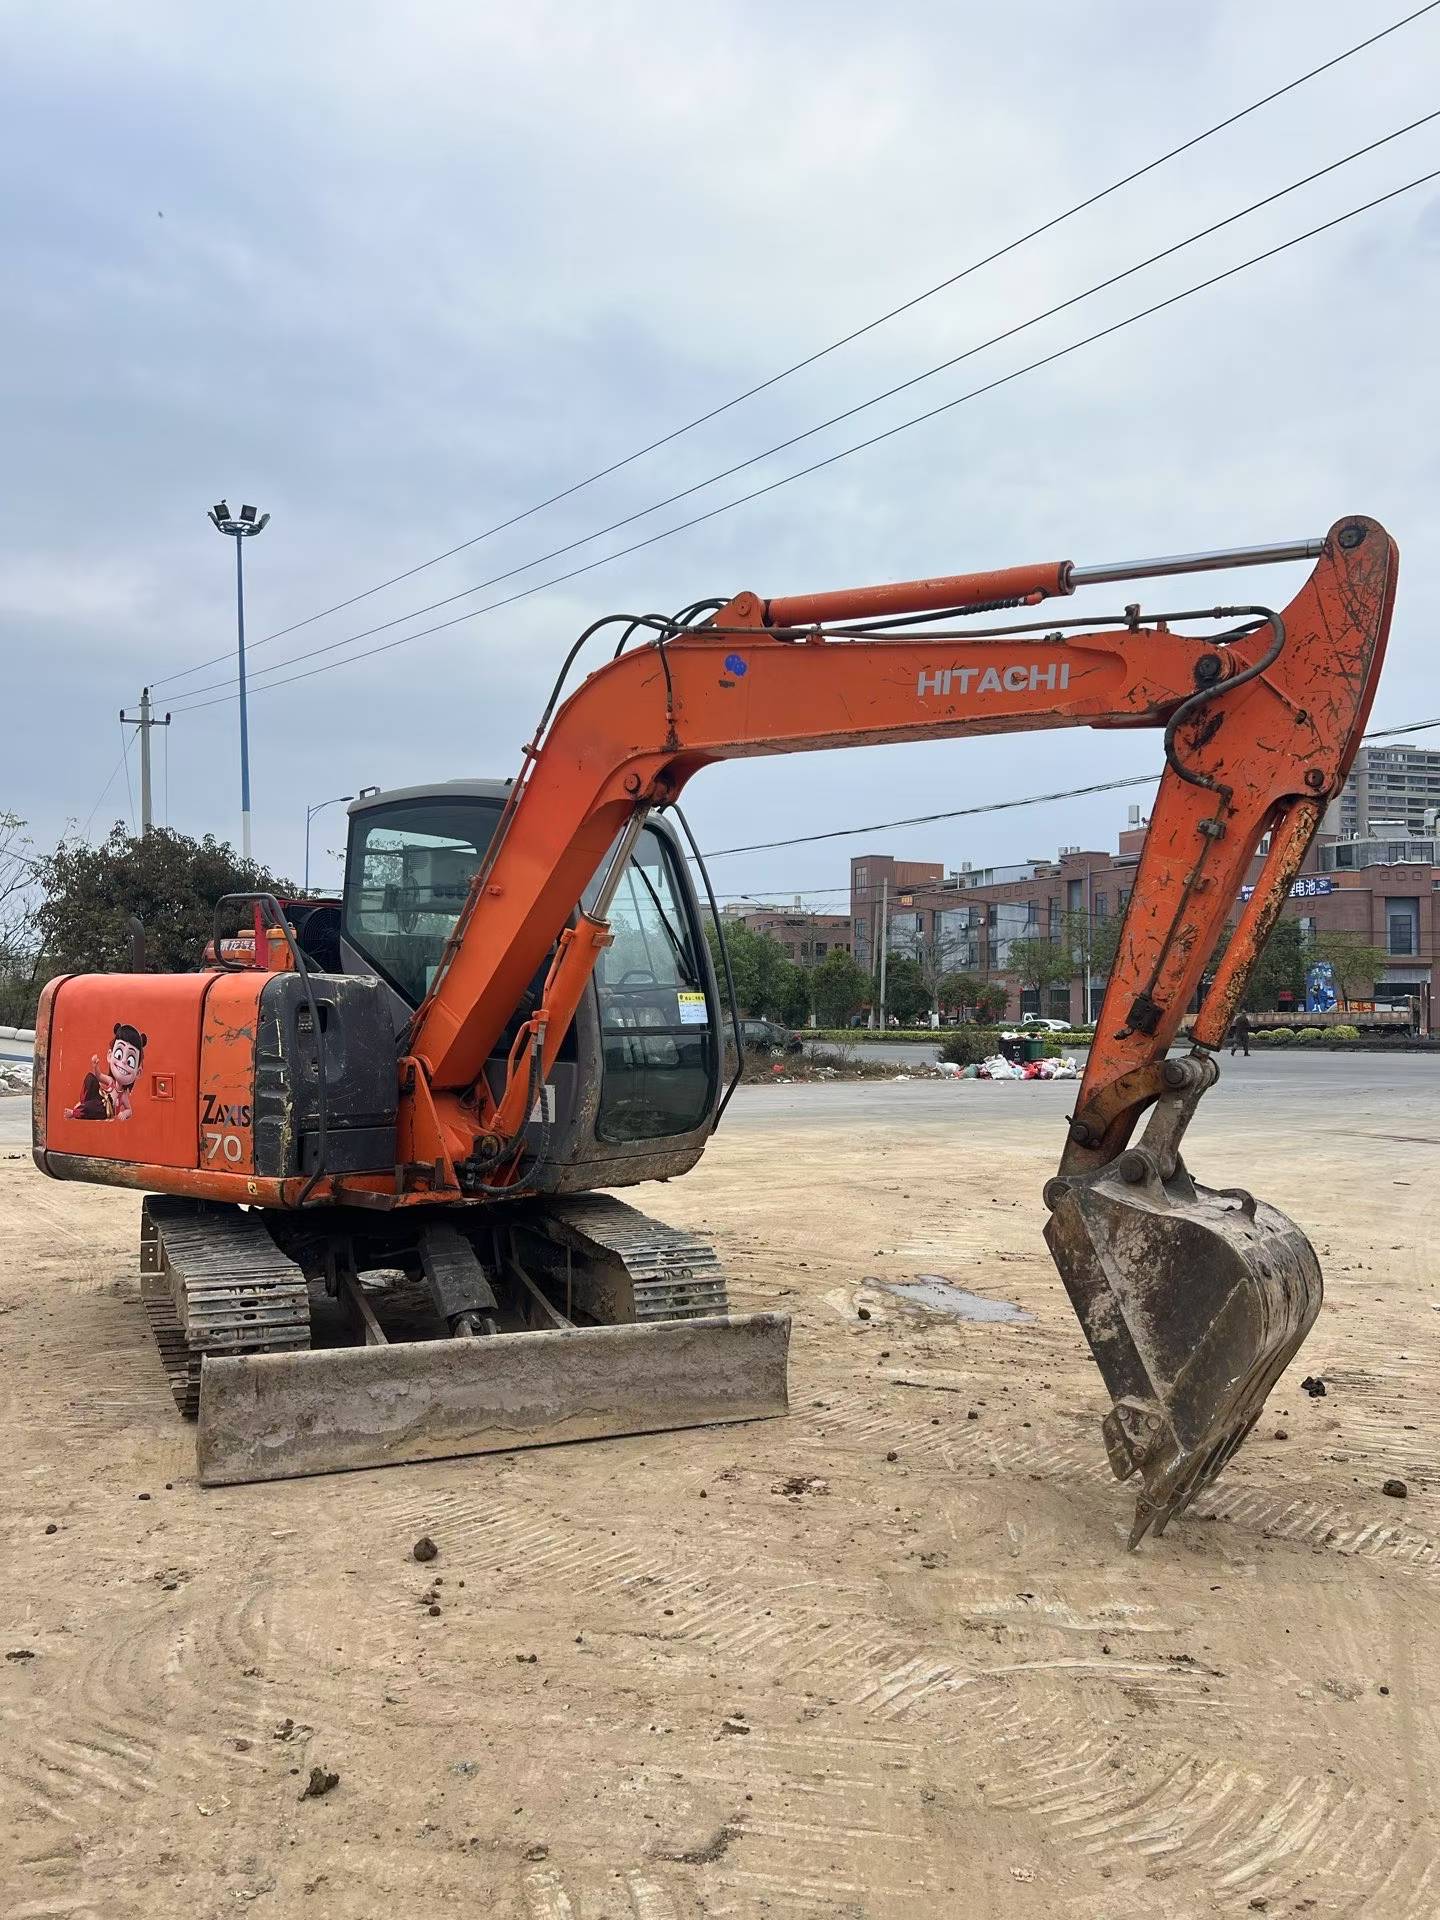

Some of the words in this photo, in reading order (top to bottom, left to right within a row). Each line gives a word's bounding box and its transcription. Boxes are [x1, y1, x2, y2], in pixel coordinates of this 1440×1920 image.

[917, 664, 1070, 696] HITACHI
[201, 1094, 251, 1127] ZAXIS
[206, 1132, 242, 1162] 70
